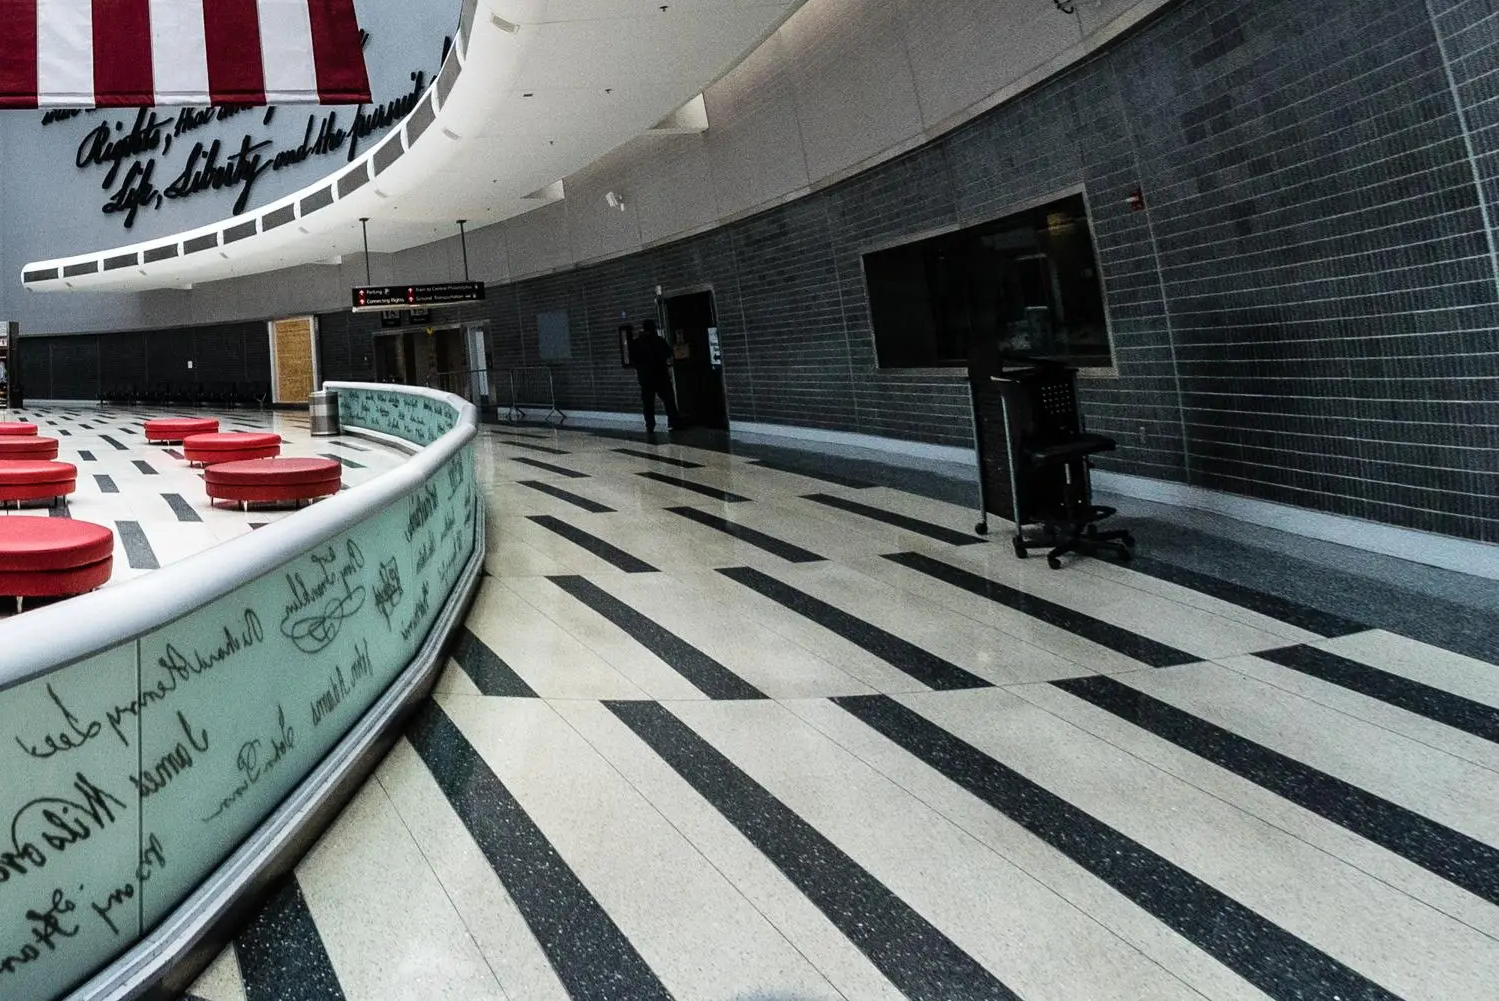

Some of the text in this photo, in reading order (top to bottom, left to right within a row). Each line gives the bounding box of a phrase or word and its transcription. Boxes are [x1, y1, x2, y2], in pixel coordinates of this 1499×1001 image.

[163, 134, 273, 215] Liberty
[272, 114, 314, 170] and
[310, 111, 347, 155] the
